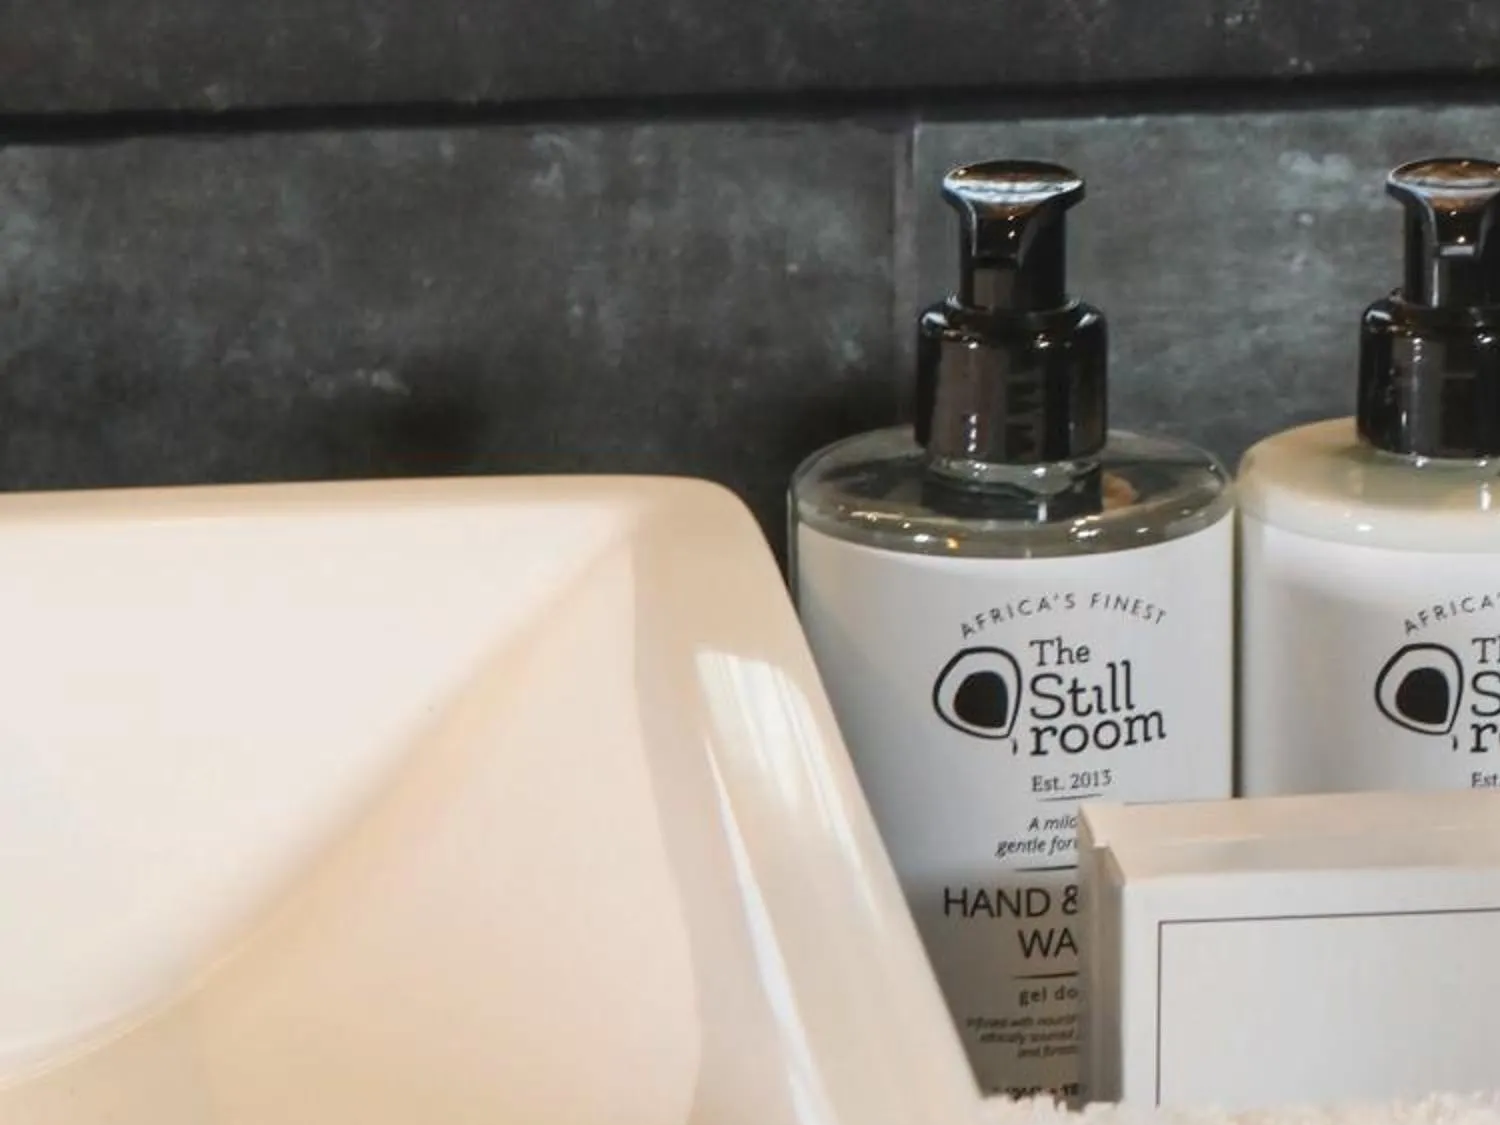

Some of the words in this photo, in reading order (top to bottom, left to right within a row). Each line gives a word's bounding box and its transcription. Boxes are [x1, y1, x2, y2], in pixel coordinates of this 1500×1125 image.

[961, 592, 1077, 639] AFRICA'S
[1089, 592, 1167, 624] FINEST
[1029, 636, 1091, 667] The
[1029, 660, 1135, 720] Still
[1029, 710, 1167, 756] room
[1032, 775, 1065, 792] Est.
[1070, 768, 1113, 789] 2013
[1027, 815, 1040, 832] A
[994, 837, 1046, 859] gentle
[943, 886, 1050, 918] HAND
[1018, 986, 1047, 1007] gel
